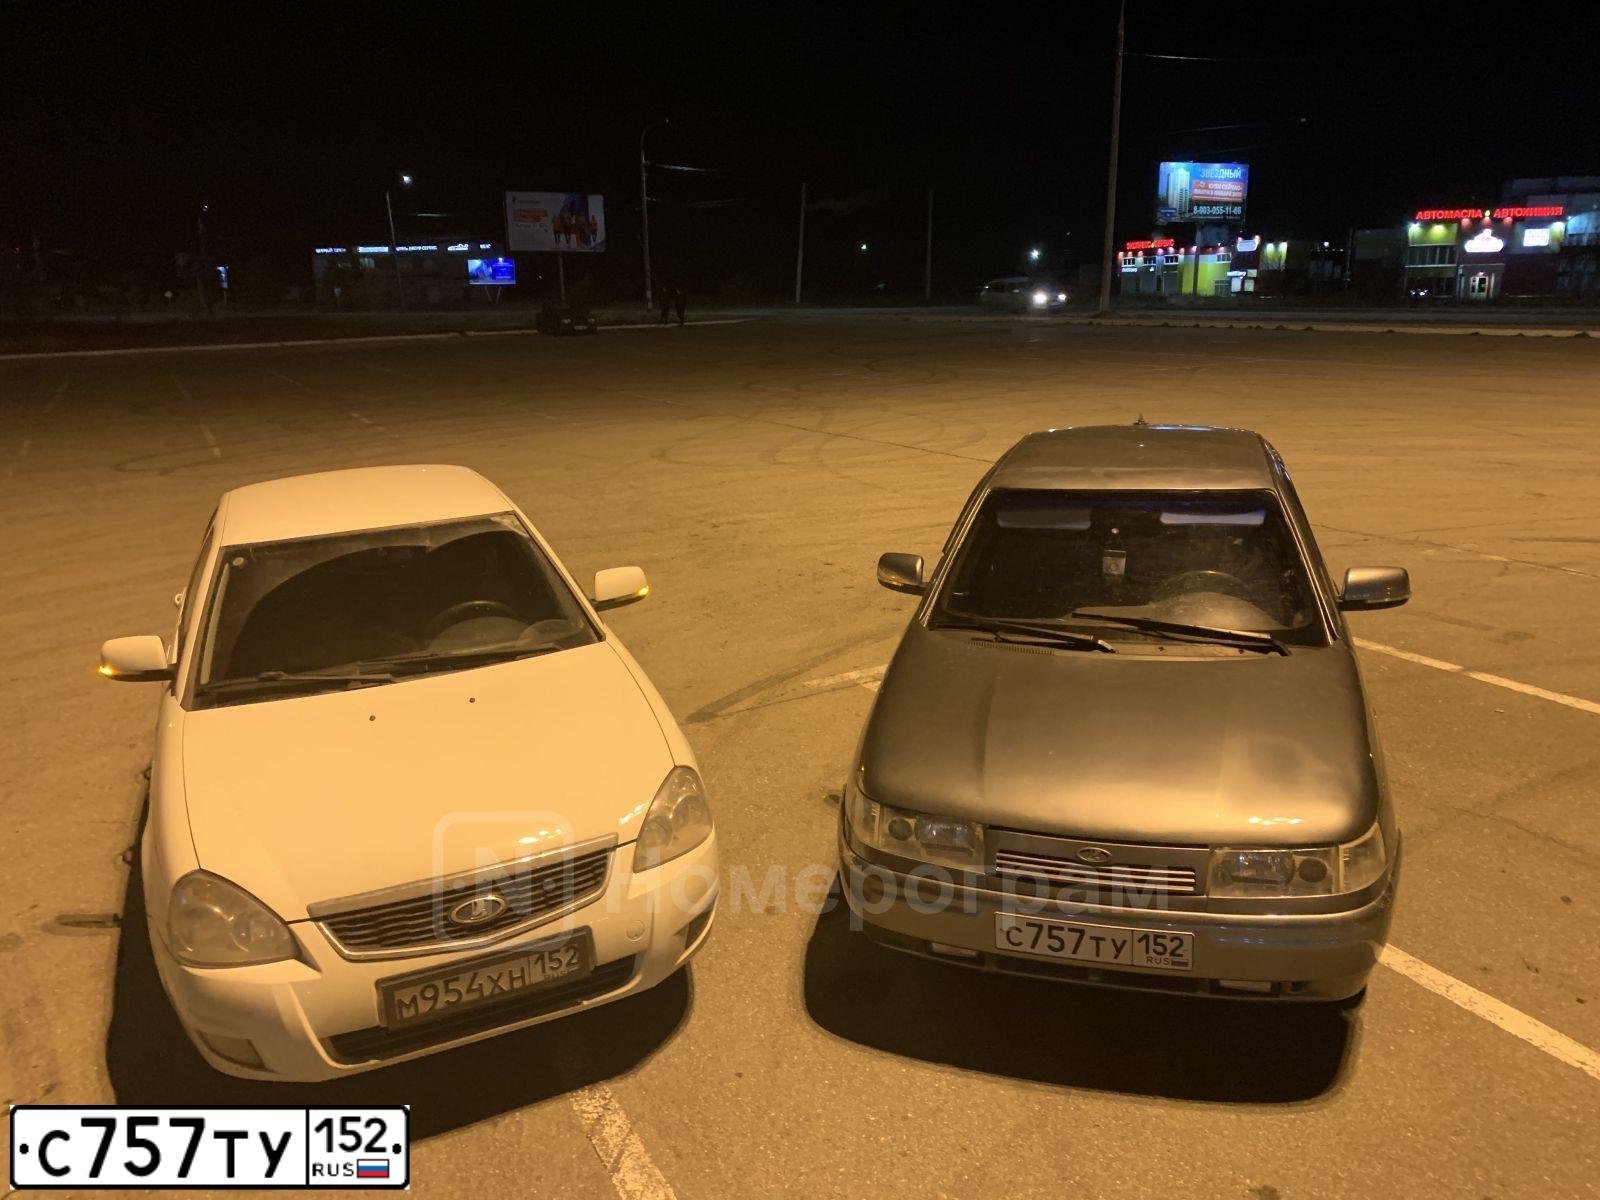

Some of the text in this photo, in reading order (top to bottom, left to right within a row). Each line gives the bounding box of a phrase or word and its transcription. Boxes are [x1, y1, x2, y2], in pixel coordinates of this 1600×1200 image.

[1200, 167, 1242, 179] ЗВЕЗДНЫЙ
[1416, 206, 1563, 220] АВТОМАСЛА АВТОХИМИЯ
[1006, 922, 1185, 960] С757ТУ 152
[1146, 955, 1170, 966] RUS
[397, 944, 580, 1017] М954ХН 152
